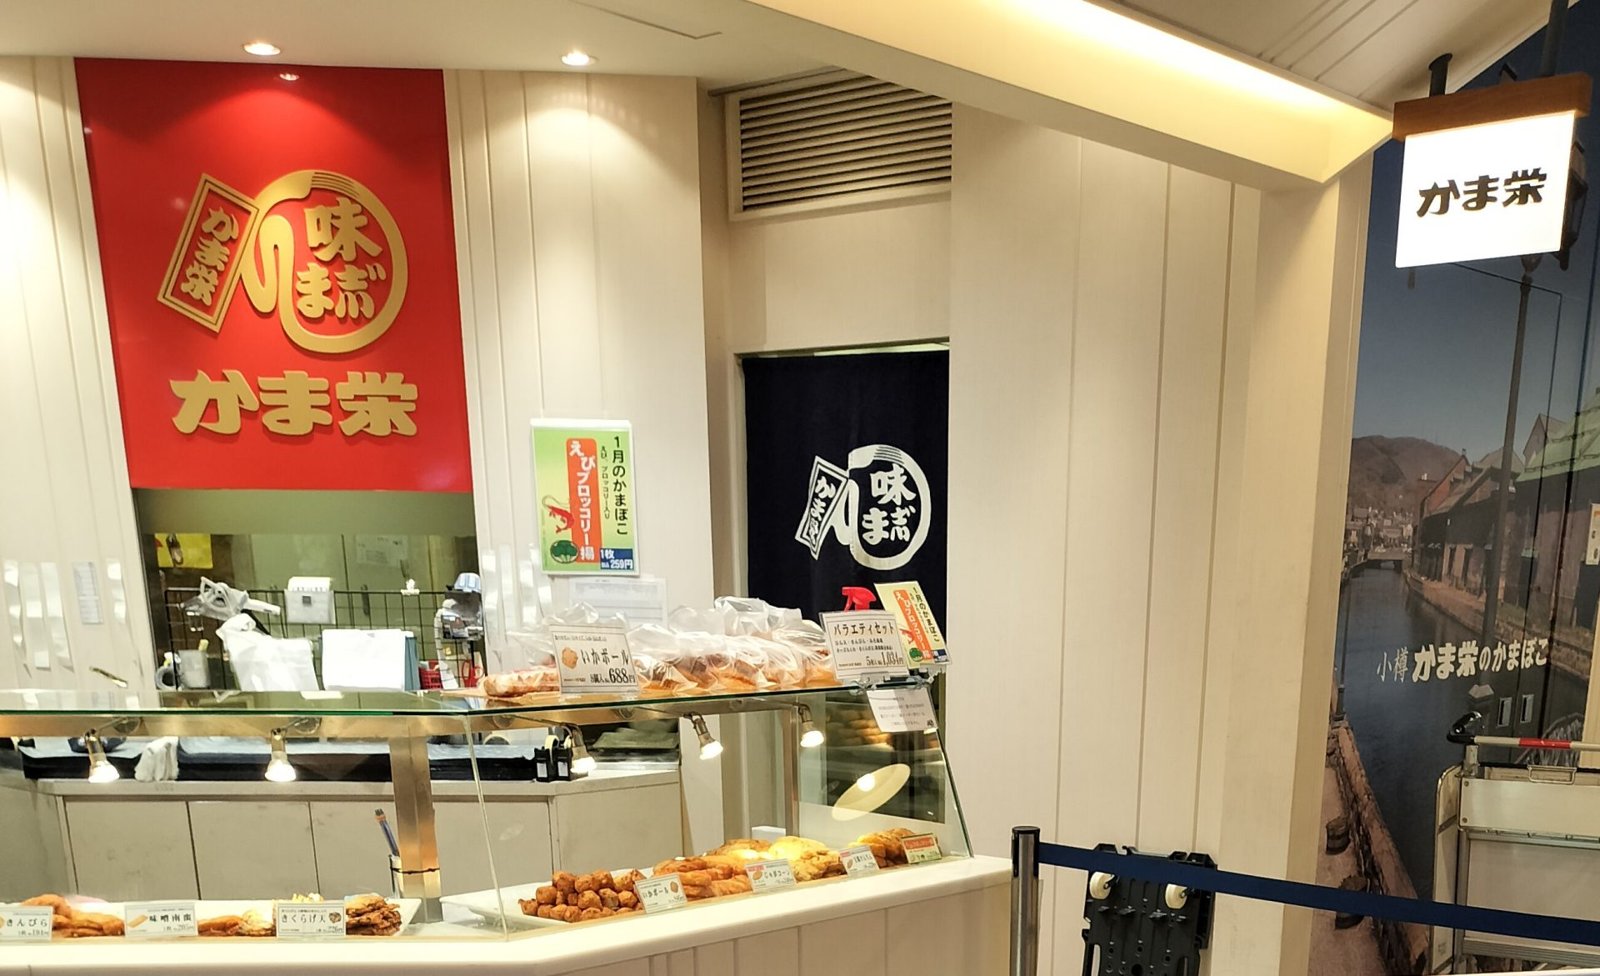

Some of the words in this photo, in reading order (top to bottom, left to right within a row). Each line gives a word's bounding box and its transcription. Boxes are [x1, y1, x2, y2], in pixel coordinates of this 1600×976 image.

[1416, 167, 1547, 218] かま栄
[180, 206, 239, 306] かま栄
[169, 369, 418, 436] かま栄
[612, 436, 628, 535] 1月のかまぼこ
[580, 648, 629, 665] いかボール
[834, 622, 894, 636] バラエティセット
